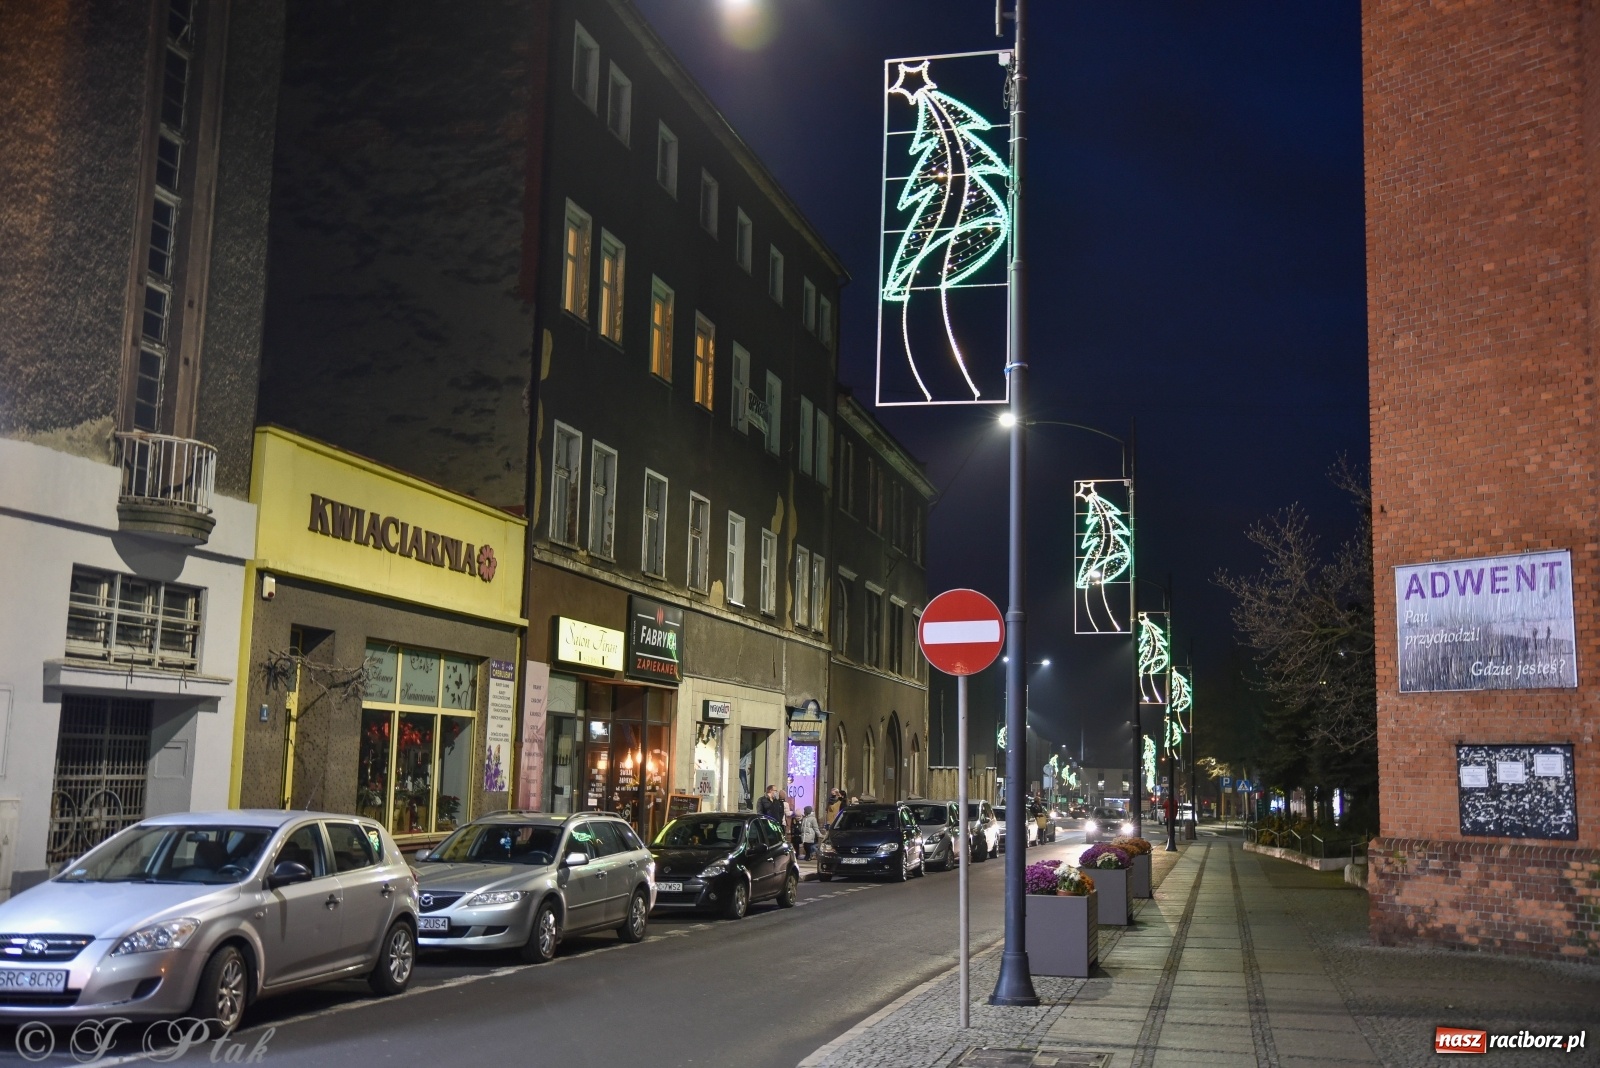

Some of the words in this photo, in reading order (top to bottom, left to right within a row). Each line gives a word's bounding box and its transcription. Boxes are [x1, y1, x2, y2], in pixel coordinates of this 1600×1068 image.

[308, 493, 477, 577] KWIACIARNIA
[1404, 561, 1562, 600] ADWENT
[1404, 610, 1429, 624] Pan
[640, 625, 677, 650] FABRYKA
[1404, 627, 1481, 650] przychodzi!
[1471, 661, 1512, 676] Gdzie
[1516, 659, 1566, 680] jesteś?
[1223, 777, 1230, 786] P
[423, 918, 446, 928] 2US4
[29, 972, 63, 987] 8CR9
